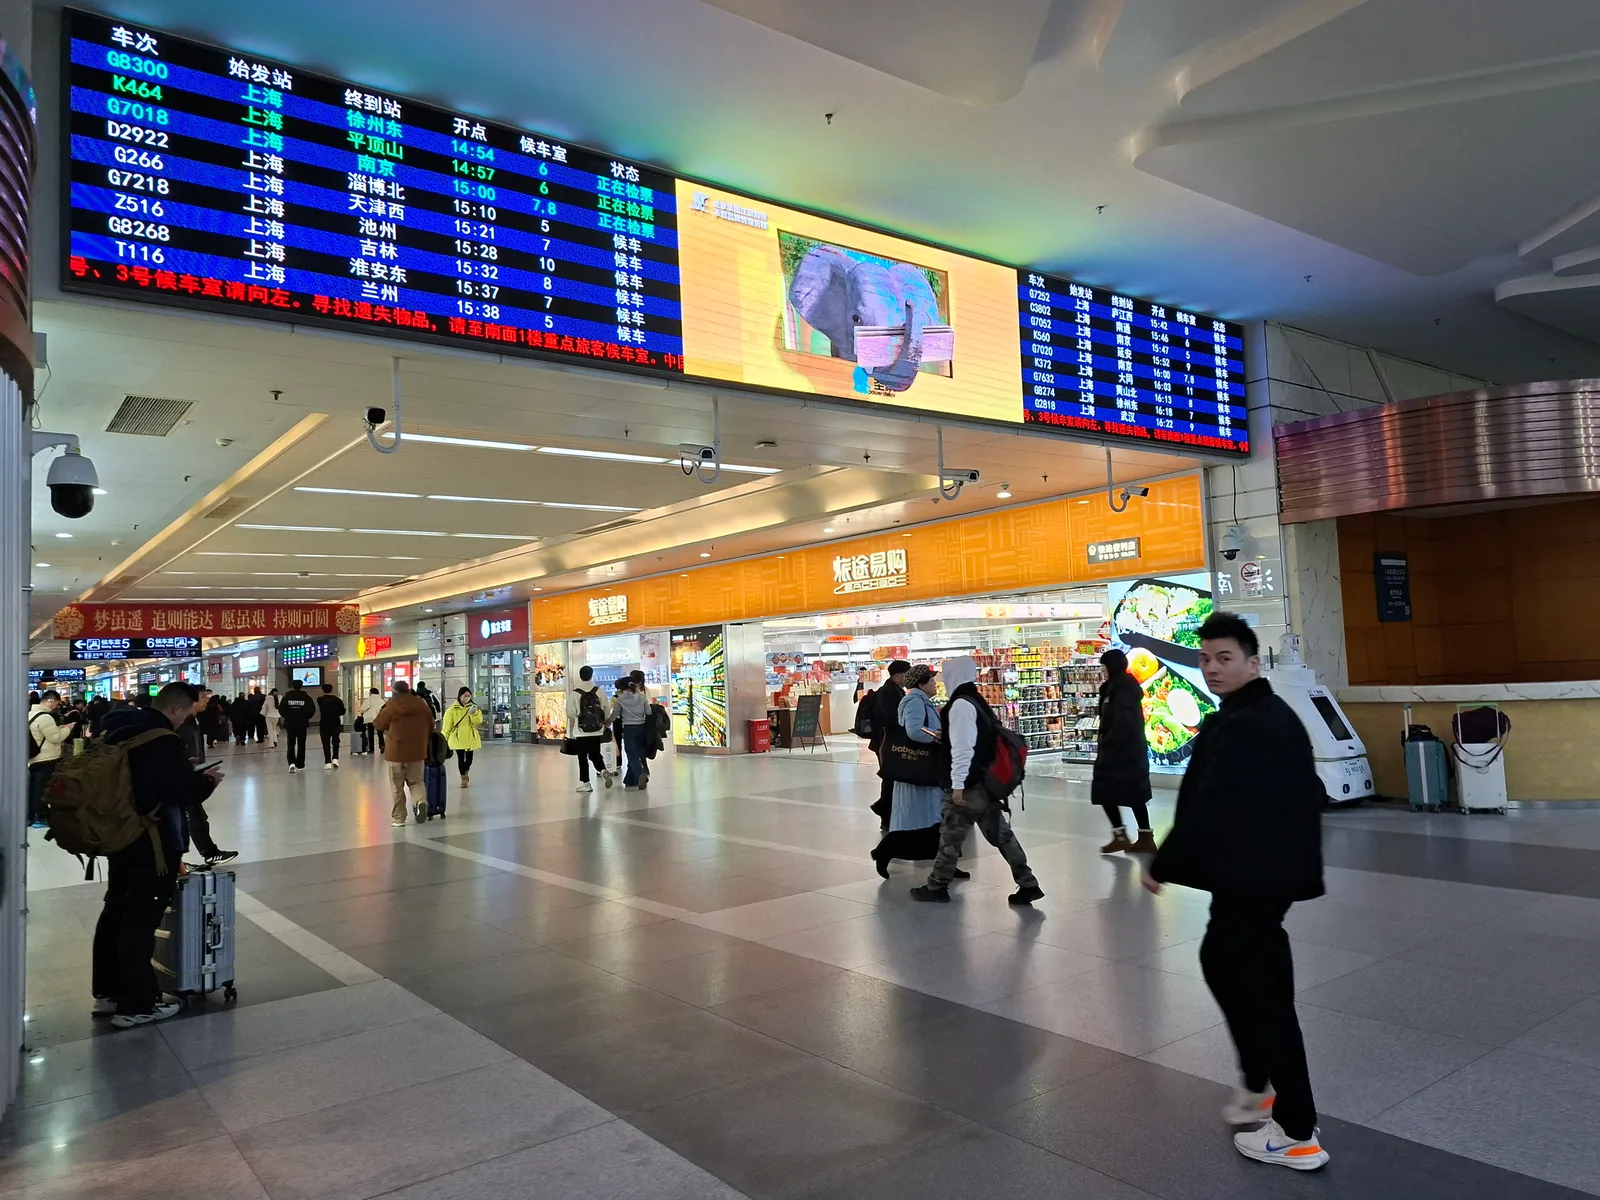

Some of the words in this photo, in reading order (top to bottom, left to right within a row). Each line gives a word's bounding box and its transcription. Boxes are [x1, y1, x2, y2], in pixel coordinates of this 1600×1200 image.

[107, 51, 168, 79] G8300
[241, 84, 282, 111] 上海
[347, 109, 403, 138] 徐州东
[452, 140, 494, 161] 14:54
[539, 163, 548, 175] 6
[597, 176, 653, 203] 正在检票
[111, 27, 158, 55] 车次
[229, 57, 292, 90] 始发站
[345, 89, 401, 118] 终到站
[453, 118, 487, 148] 开点
[520, 136, 567, 163] 候车室
[610, 161, 642, 188] 状态
[108, 98, 168, 125] G7018
[242, 128, 283, 155] 上海
[358, 155, 395, 177] 南京
[453, 179, 495, 200] 15:00
[598, 212, 655, 239] 正在检票
[114, 75, 162, 100] K464
[242, 106, 283, 133] 上海
[347, 131, 403, 159] 平顶山
[453, 160, 494, 180] 14:57
[540, 182, 548, 194] 6
[597, 194, 654, 221] 正在检票
[108, 120, 168, 148] D2922
[242, 150, 284, 174] 上海
[348, 172, 405, 200] 淄博北
[454, 199, 496, 220] 15:10
[541, 220, 549, 232] 5
[613, 233, 642, 253] 候车
[114, 147, 163, 170] G266
[243, 172, 284, 195] 上海
[348, 194, 405, 220] 天津西
[455, 220, 494, 239] 15:21
[542, 239, 550, 250] 7
[614, 252, 643, 271] 候车
[108, 169, 169, 194] G7218
[243, 194, 284, 221] 上海
[359, 217, 396, 240] 池州
[455, 240, 497, 260] 15:28
[540, 257, 555, 271] 10
[615, 270, 643, 290] 候车
[115, 193, 163, 217] Z516
[244, 216, 285, 239] 上海
[360, 238, 398, 260] 吉林
[456, 260, 498, 279] 15:32
[544, 277, 552, 290] 8
[615, 289, 644, 308] 候车
[109, 217, 169, 241] G8268
[244, 239, 285, 261] 上海
[350, 258, 407, 283] 淮安东
[457, 280, 499, 299] 15:37
[545, 296, 552, 308] 7
[616, 307, 645, 326] 候车
[115, 241, 164, 263] T116
[244, 261, 285, 283] 上海
[361, 281, 397, 302] 兰州
[457, 300, 499, 319] 15:38
[545, 316, 553, 328] 5
[617, 325, 646, 344] 候车
[1029, 274, 1045, 288] 车次
[1070, 284, 1092, 301] 始发站
[1112, 295, 1133, 313] 终到站
[1152, 305, 1165, 318] 开点
[1176, 312, 1196, 325] 候车室
[1213, 321, 1225, 333] 状态
[1029, 289, 1050, 302] G7252
[1075, 299, 1089, 312] 上海
[1151, 319, 1167, 330] 15:42
[1185, 327, 1188, 335] 8
[1214, 332, 1226, 344] 候车
[1033, 330, 1050, 342] K560
[1077, 338, 1091, 351] 上海
[1117, 347, 1132, 359] 延安
[1153, 356, 1170, 367] 15:52
[1187, 363, 1190, 371] 9
[1216, 367, 1228, 379] 候车
[1075, 312, 1090, 325] 上海
[1151, 331, 1168, 342] 15:46
[1185, 339, 1189, 347] 6
[1214, 344, 1227, 358] 候车
[1076, 325, 1091, 338] 上海
[1117, 334, 1131, 349] 南京
[1152, 344, 1169, 354] 15:47
[1186, 351, 1190, 359] 5
[1215, 356, 1227, 368] 候车
[1032, 344, 1053, 356] G7020
[1078, 351, 1092, 364] 上海
[1118, 359, 1132, 375] 南京
[1153, 369, 1170, 379] 16:00
[1216, 379, 1228, 390] 候车
[1034, 372, 1054, 383] G7632
[1079, 378, 1093, 391] 上海
[1116, 385, 1137, 398] 黄山北
[1155, 394, 1172, 404] 16:13
[1189, 399, 1192, 407] 8
[1218, 403, 1230, 414] 候车
[1035, 357, 1051, 369] K372
[1078, 365, 1093, 377] 上海
[1119, 372, 1133, 385] 大同
[1154, 381, 1171, 391] 16:03
[1187, 387, 1192, 395] 11
[1217, 391, 1229, 402] 候车
[1034, 385, 1055, 397] G8274
[1079, 392, 1094, 404] 上海
[1116, 398, 1138, 413] 徐州东
[1156, 406, 1172, 416] 16:18
[1218, 415, 1231, 427] 候车
[1035, 399, 1055, 410] G2818
[1080, 404, 1095, 416] 上海
[1121, 411, 1135, 423] 武汉
[1156, 418, 1173, 428] 16:22
[1190, 423, 1194, 431] 9
[1219, 426, 1231, 437] 候车
[833, 549, 907, 582] 旅途易购
[93, 609, 144, 632] 梦虽遥
[151, 609, 214, 631] 追则能达
[221, 609, 266, 630] 愿虽艰
[273, 608, 329, 629] 持则可圆
